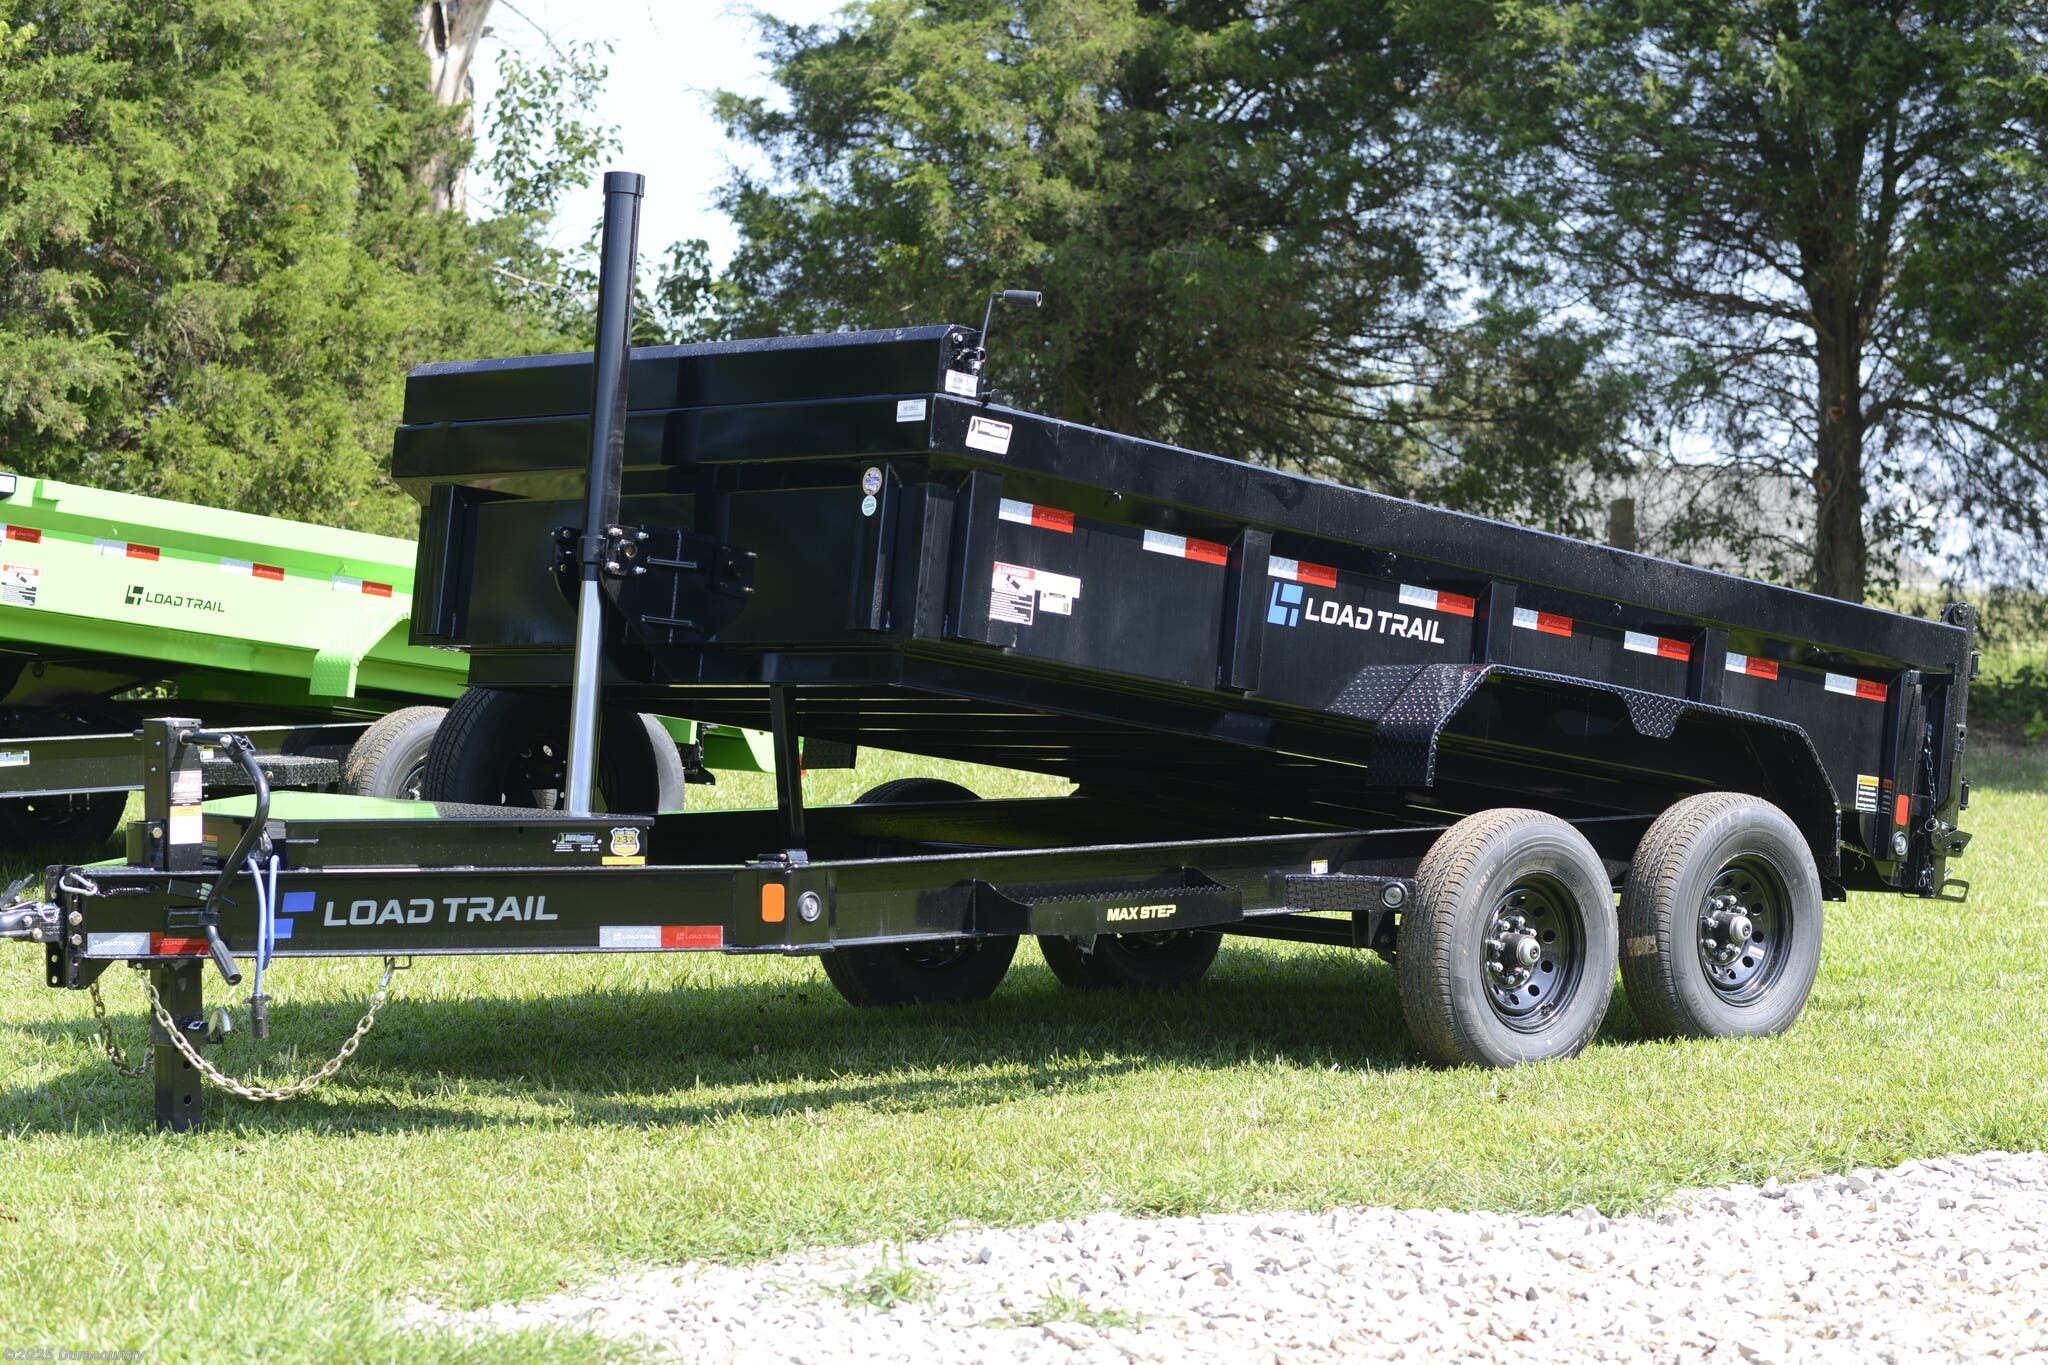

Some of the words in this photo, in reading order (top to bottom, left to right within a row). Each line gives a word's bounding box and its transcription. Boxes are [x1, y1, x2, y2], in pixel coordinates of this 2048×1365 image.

[145, 591, 183, 608] LOAD
[186, 597, 225, 613] TRAIL
[1304, 597, 1373, 631] LOAD
[1377, 610, 1446, 645] TRAIL
[323, 897, 435, 926] LOAD
[441, 895, 559, 922] TRAIL
[1107, 906, 1138, 922] MAX
[1139, 904, 1176, 919] STEP
